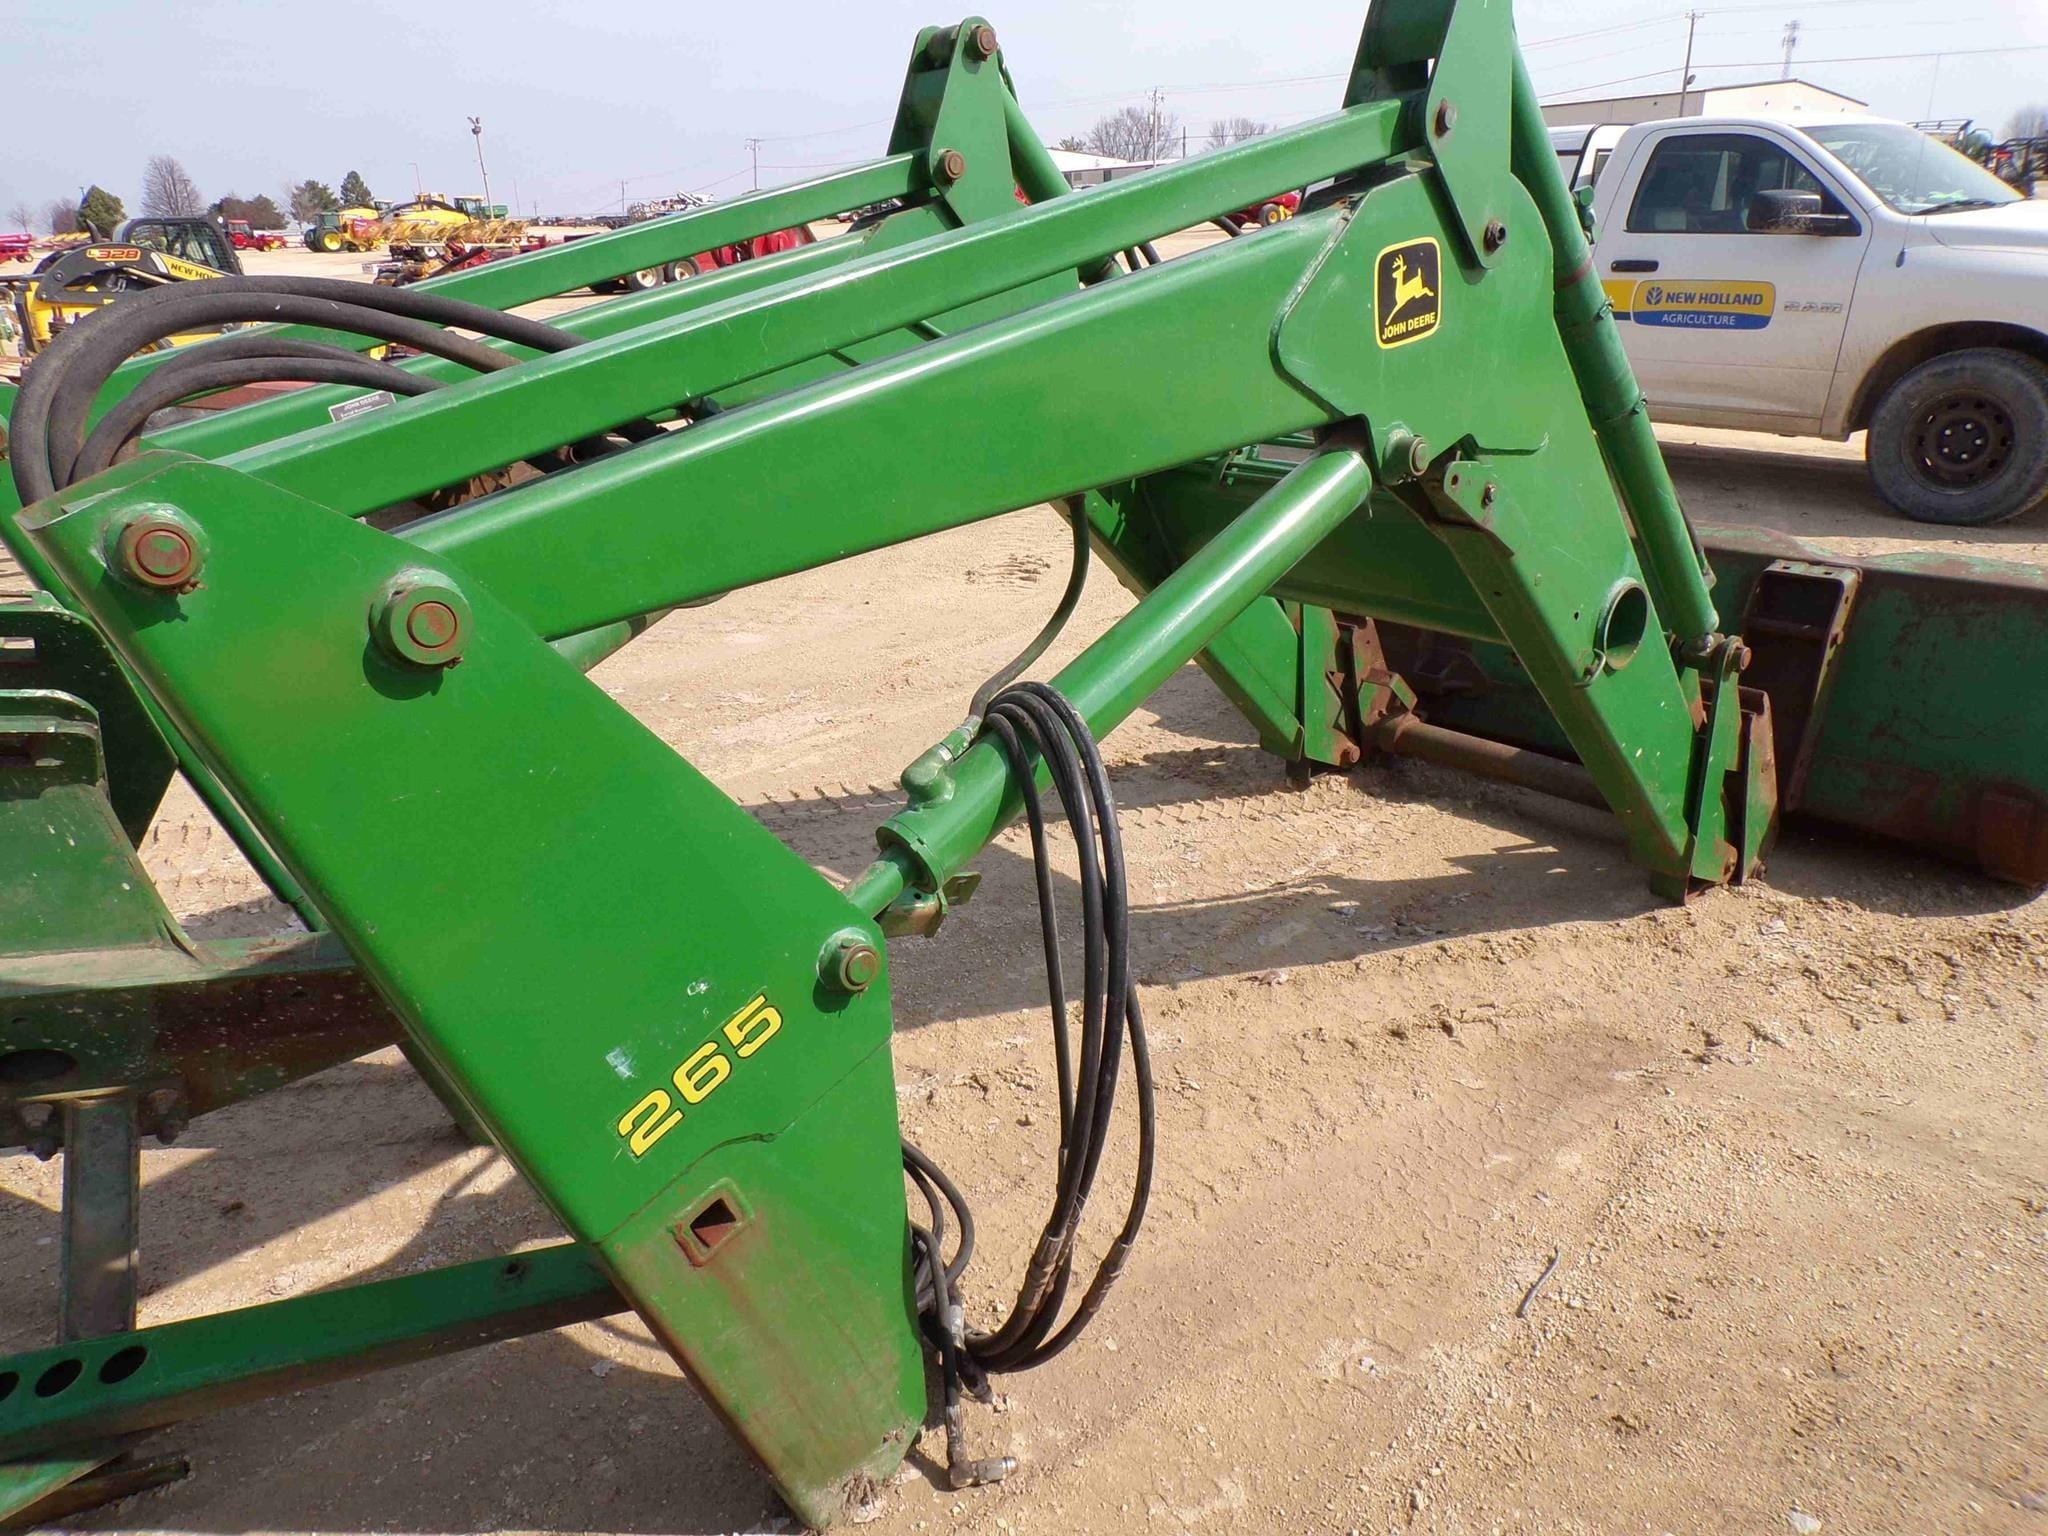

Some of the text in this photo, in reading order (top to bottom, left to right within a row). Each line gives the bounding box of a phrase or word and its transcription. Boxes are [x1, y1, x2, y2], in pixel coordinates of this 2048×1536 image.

[171, 263, 194, 275] NEW
[1665, 292, 1764, 306] NEW HOLLAND
[1382, 312, 1436, 340] JOHN DEERE
[1661, 314, 1736, 326] AGRICULTURE
[618, 994, 784, 1158] 265
